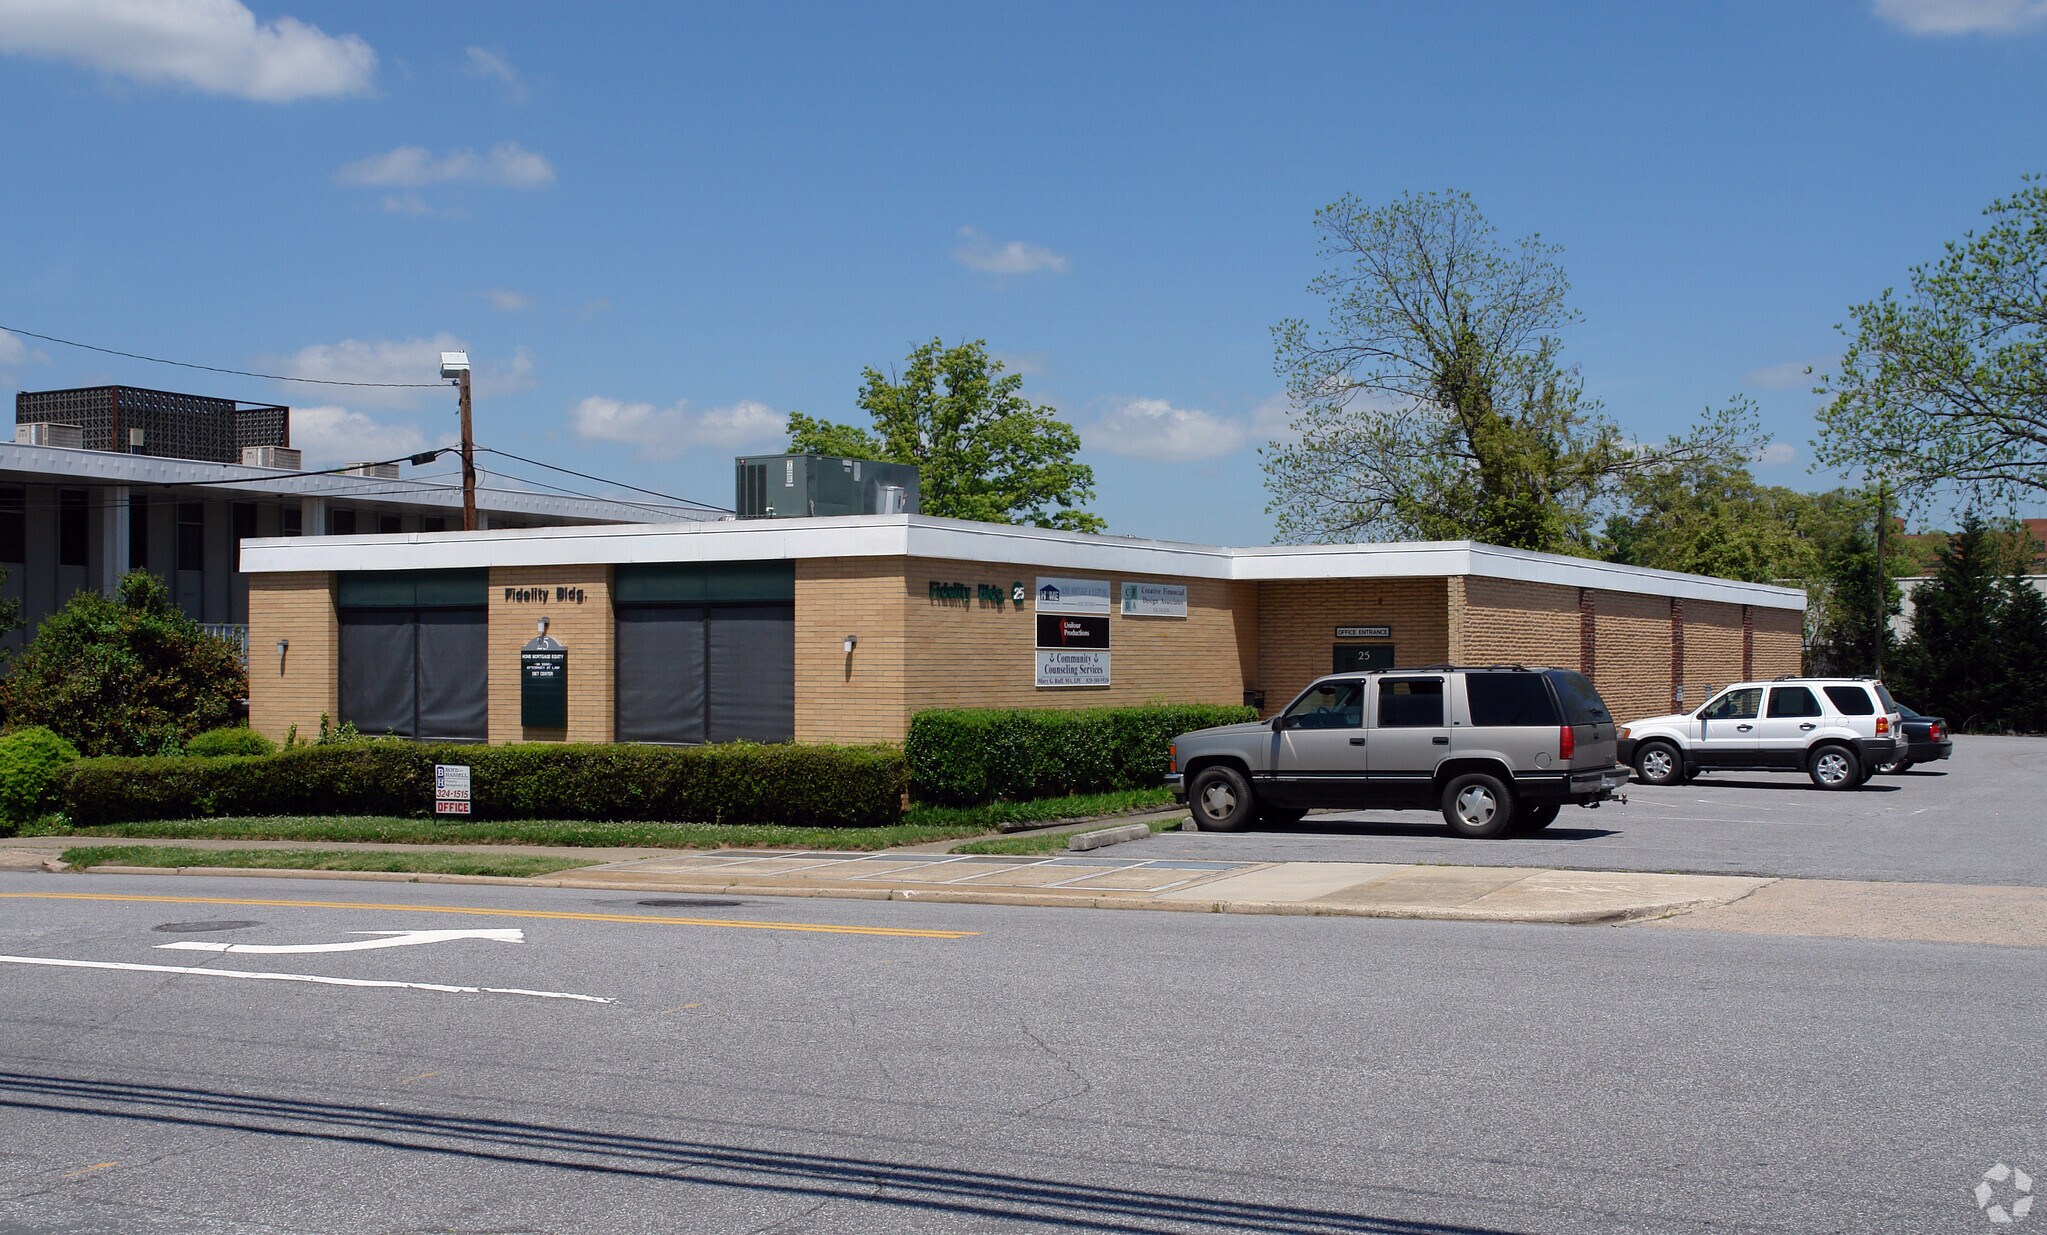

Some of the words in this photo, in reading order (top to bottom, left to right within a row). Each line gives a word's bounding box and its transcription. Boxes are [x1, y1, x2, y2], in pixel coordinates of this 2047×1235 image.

[505, 588, 549, 605] Fidelity
[557, 587, 588, 605] Bldg.
[929, 581, 971, 606] Fidelity
[1013, 587, 1025, 600] 25
[1040, 590, 1060, 601] HME
[1163, 587, 1185, 596] Financial
[1142, 596, 1159, 606] Design
[1063, 629, 1090, 637] Productions
[537, 637, 549, 651] 25
[1056, 652, 1091, 665] Community
[1358, 650, 1371, 661] 25
[1044, 663, 1079, 676] Counseling
[1079, 664, 1104, 675] Services
[437, 790, 468, 798] 324-1515
[438, 803, 469, 812] OFFICE
